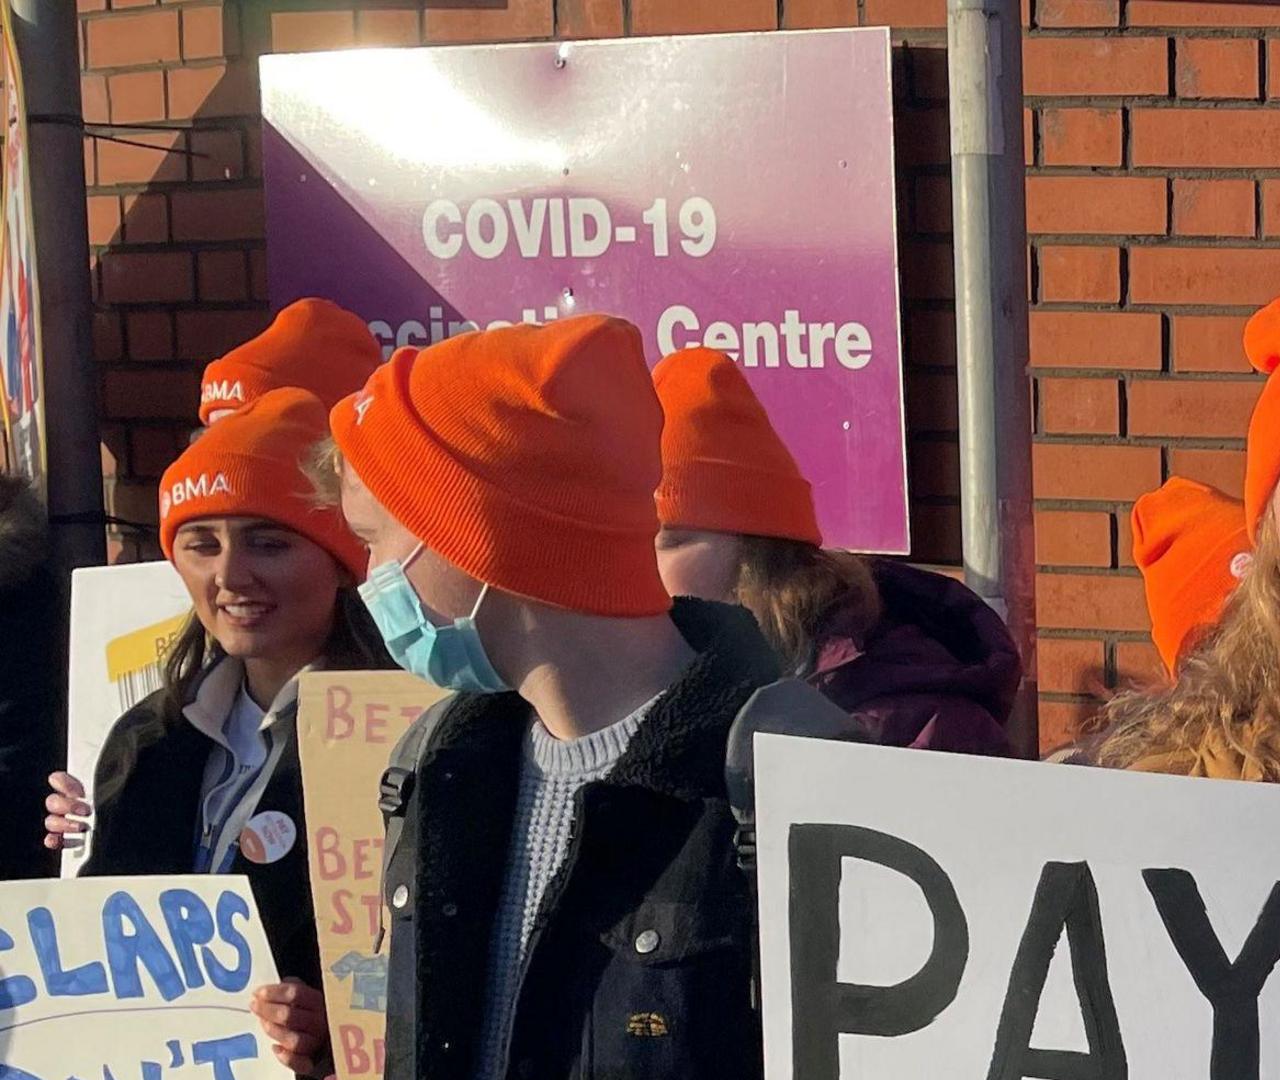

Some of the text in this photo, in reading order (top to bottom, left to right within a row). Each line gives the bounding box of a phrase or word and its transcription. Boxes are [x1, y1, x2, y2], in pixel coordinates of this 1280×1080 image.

[422, 197, 718, 259] COVID-19
[657, 305, 873, 369] Centre
[172, 472, 233, 505] BMA
